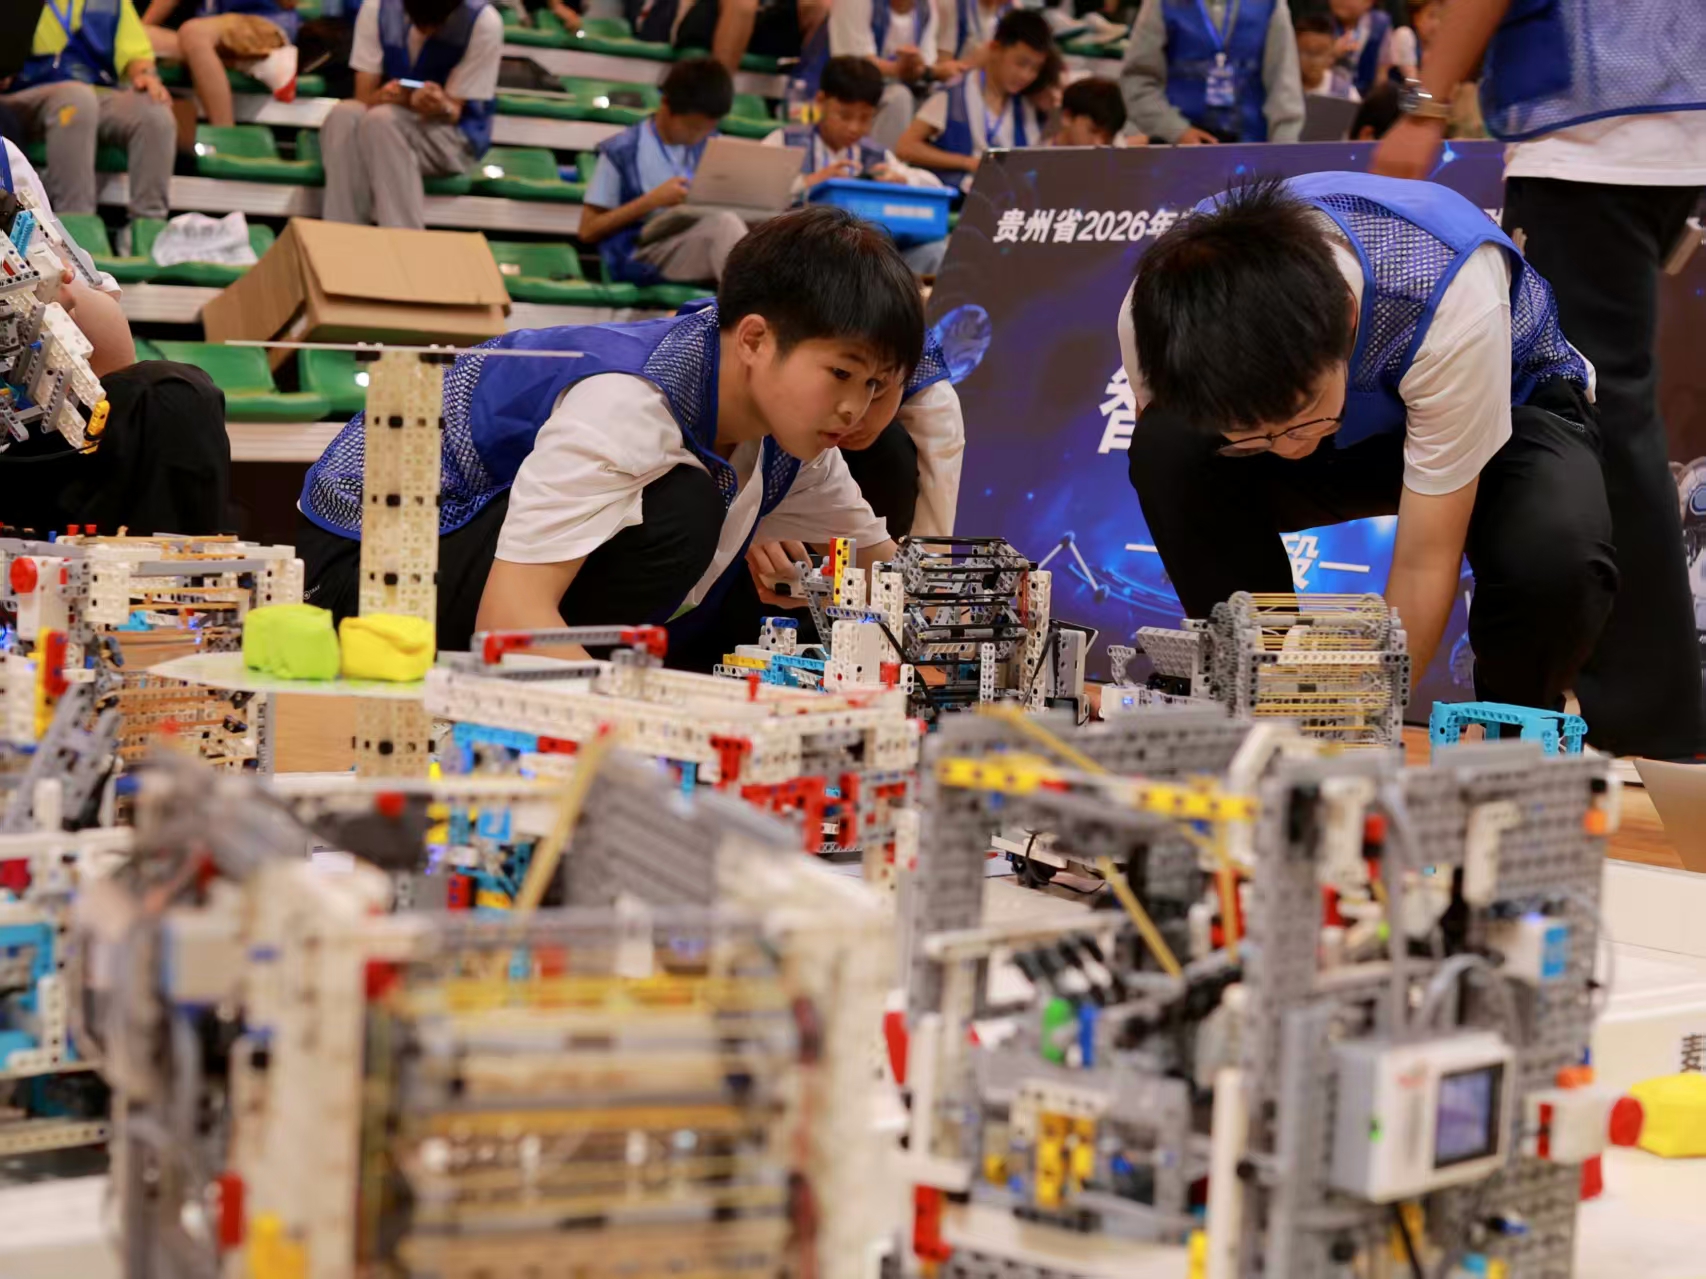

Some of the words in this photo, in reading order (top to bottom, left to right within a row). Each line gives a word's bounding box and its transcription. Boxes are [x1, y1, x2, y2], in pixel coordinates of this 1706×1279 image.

[993, 207, 1194, 243] 贵州省2026年
[1680, 1034, 1706, 1073] 麦
